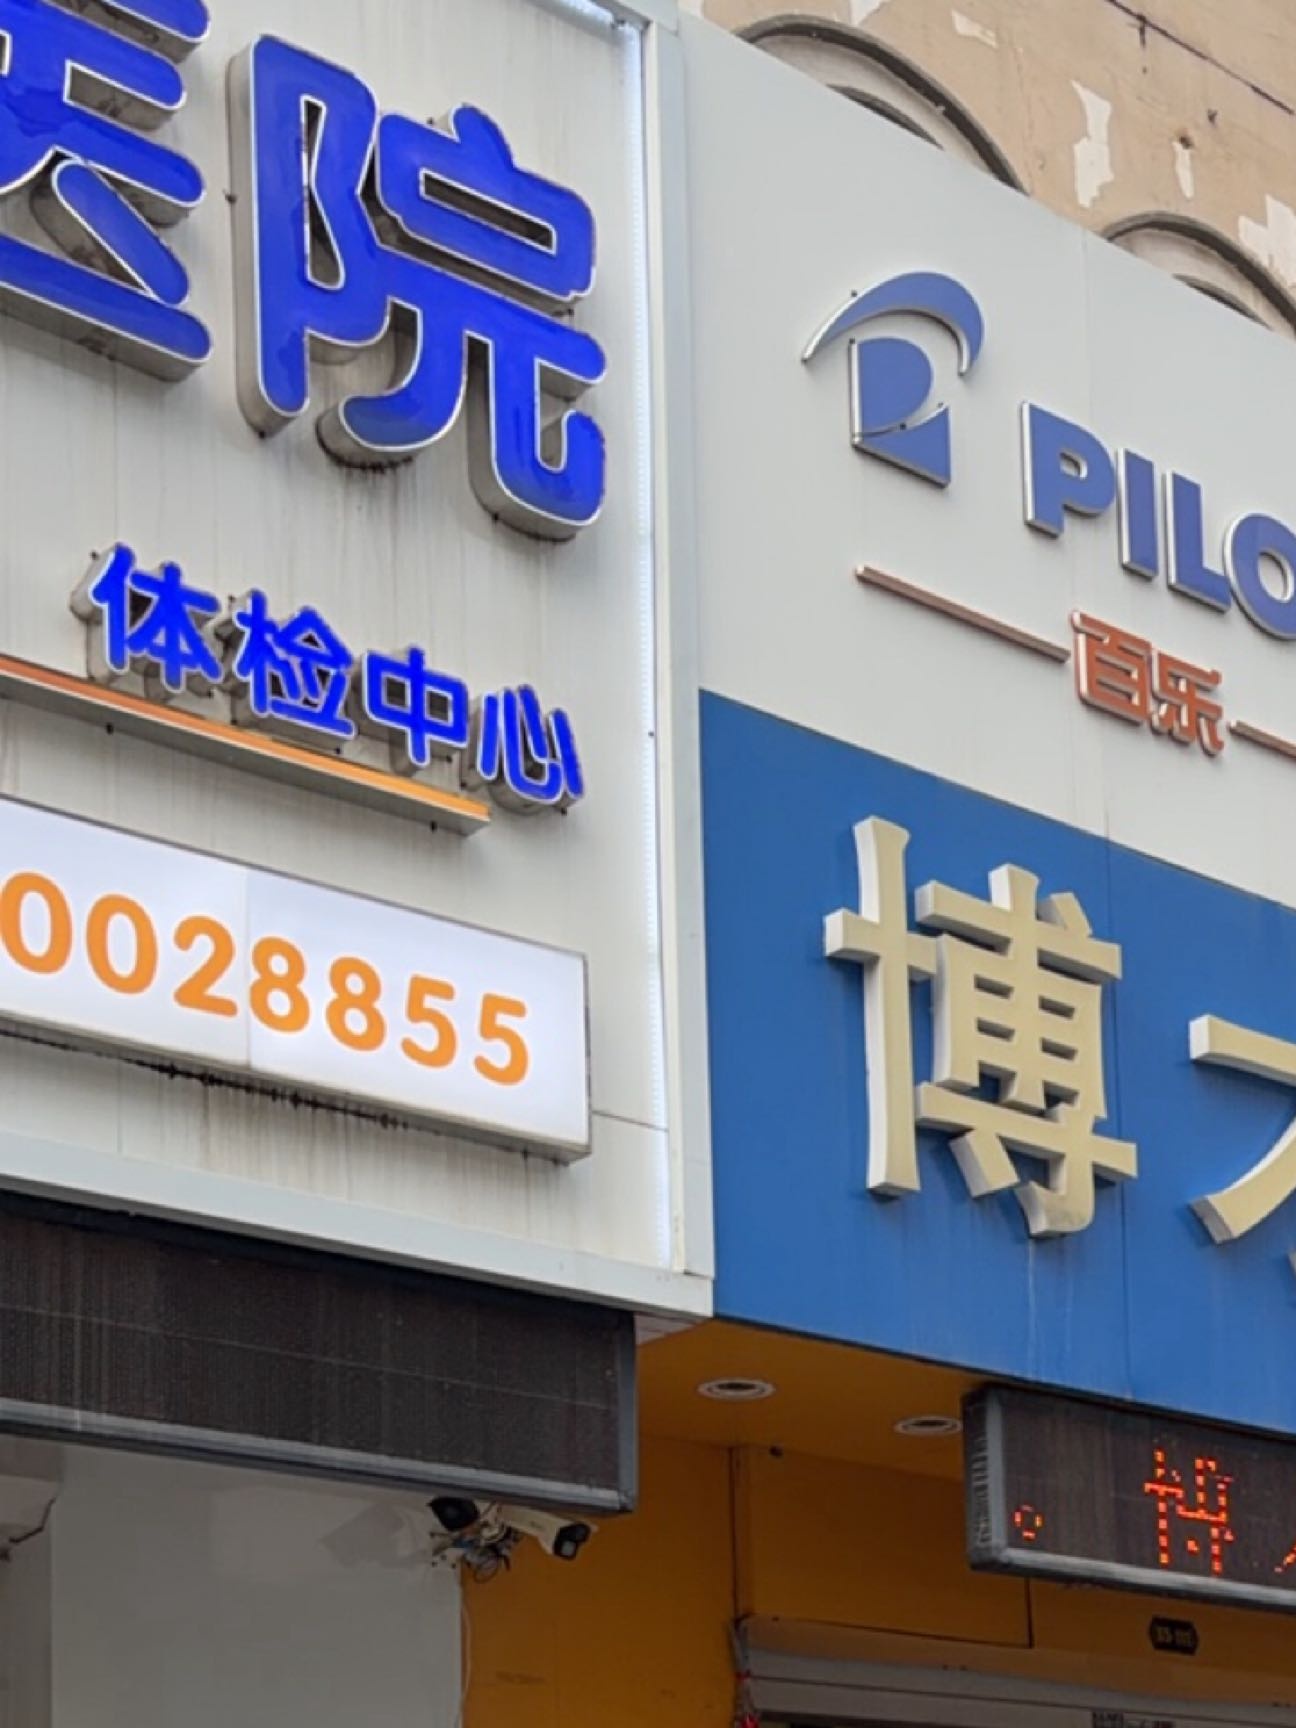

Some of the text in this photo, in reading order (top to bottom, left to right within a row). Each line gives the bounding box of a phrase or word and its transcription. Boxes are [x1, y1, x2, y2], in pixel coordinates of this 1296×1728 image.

[82, 543, 585, 801] 体检中心
[1069, 610, 1225, 758] 百乐
[0, 871, 531, 1087] 0028855
